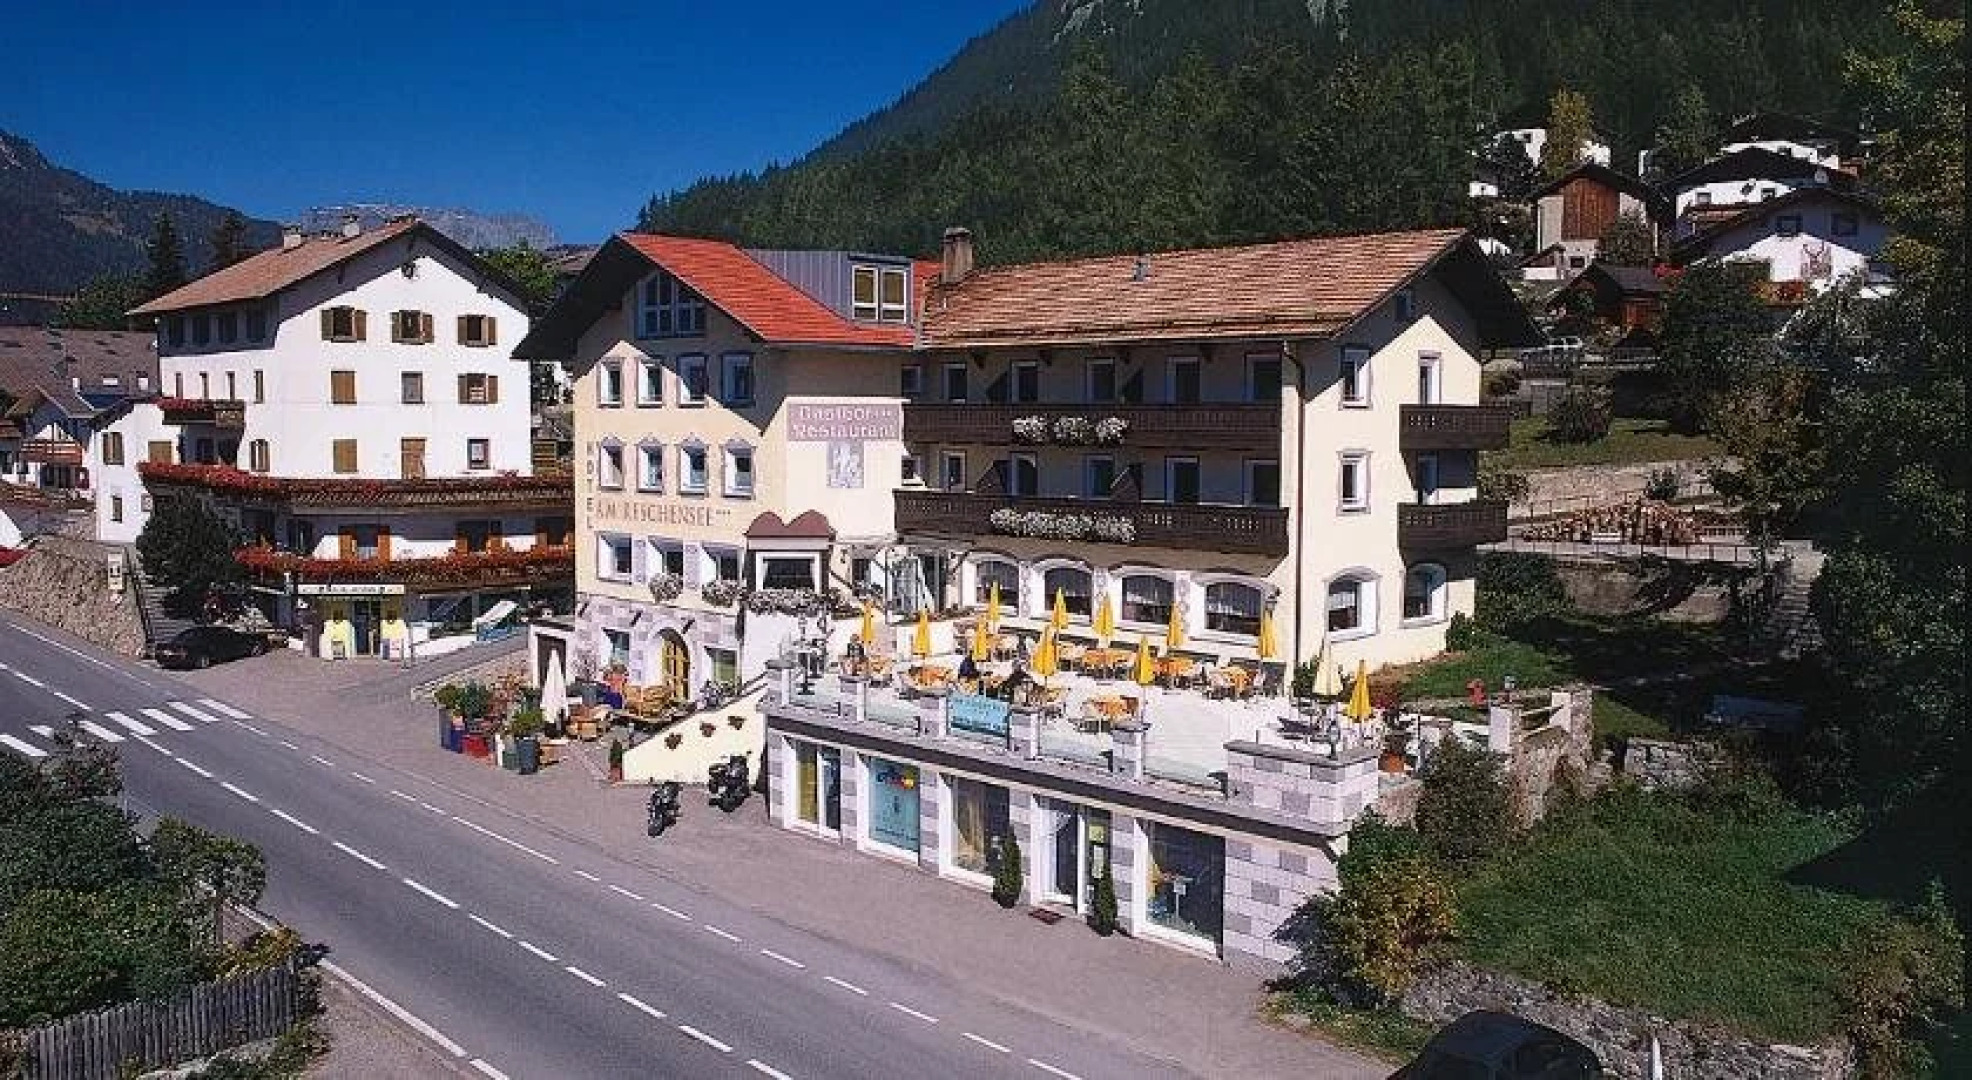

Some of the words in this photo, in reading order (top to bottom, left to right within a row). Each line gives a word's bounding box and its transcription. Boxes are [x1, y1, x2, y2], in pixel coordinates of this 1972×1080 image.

[586, 440, 595, 529] HOTEL
[595, 499, 616, 521] AM
[623, 501, 712, 527] RESCHENSEE
